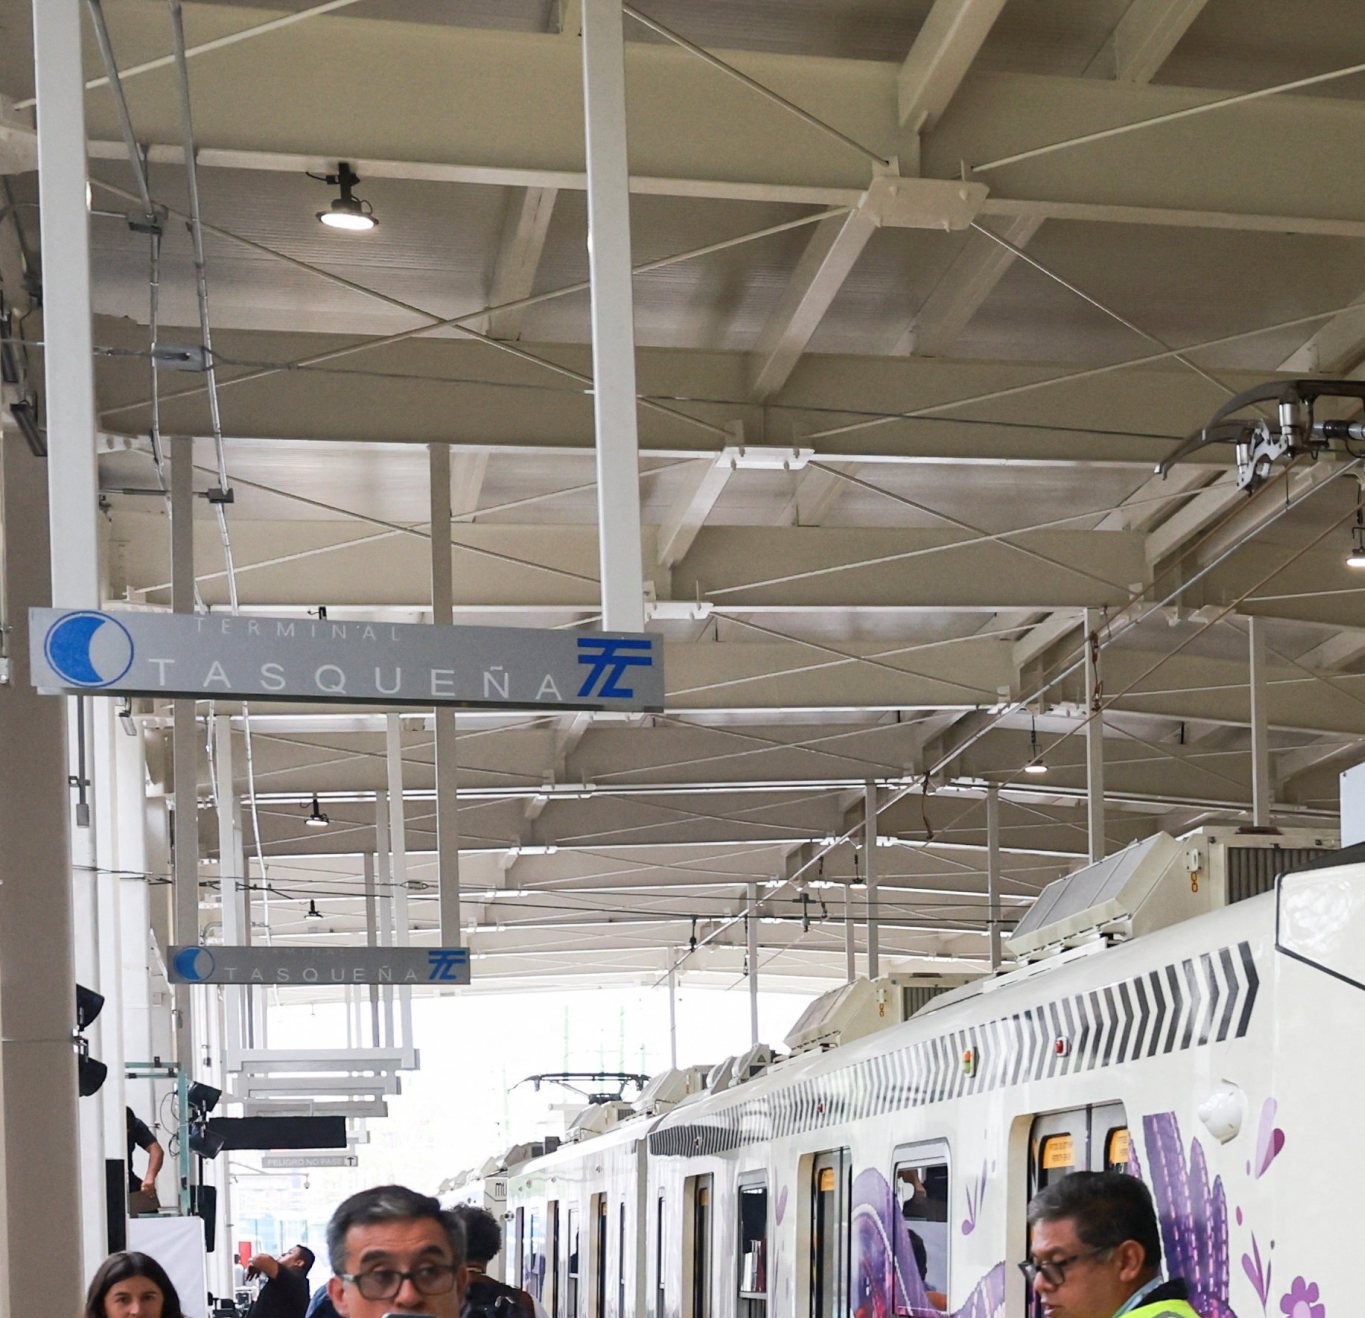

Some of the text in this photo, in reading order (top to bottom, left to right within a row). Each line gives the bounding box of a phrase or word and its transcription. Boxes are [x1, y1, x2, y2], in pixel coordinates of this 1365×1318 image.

[194, 616, 401, 641] TERMINAL
[147, 657, 564, 701] TASQUEÑA
[224, 965, 419, 983] TASQUEÑA
